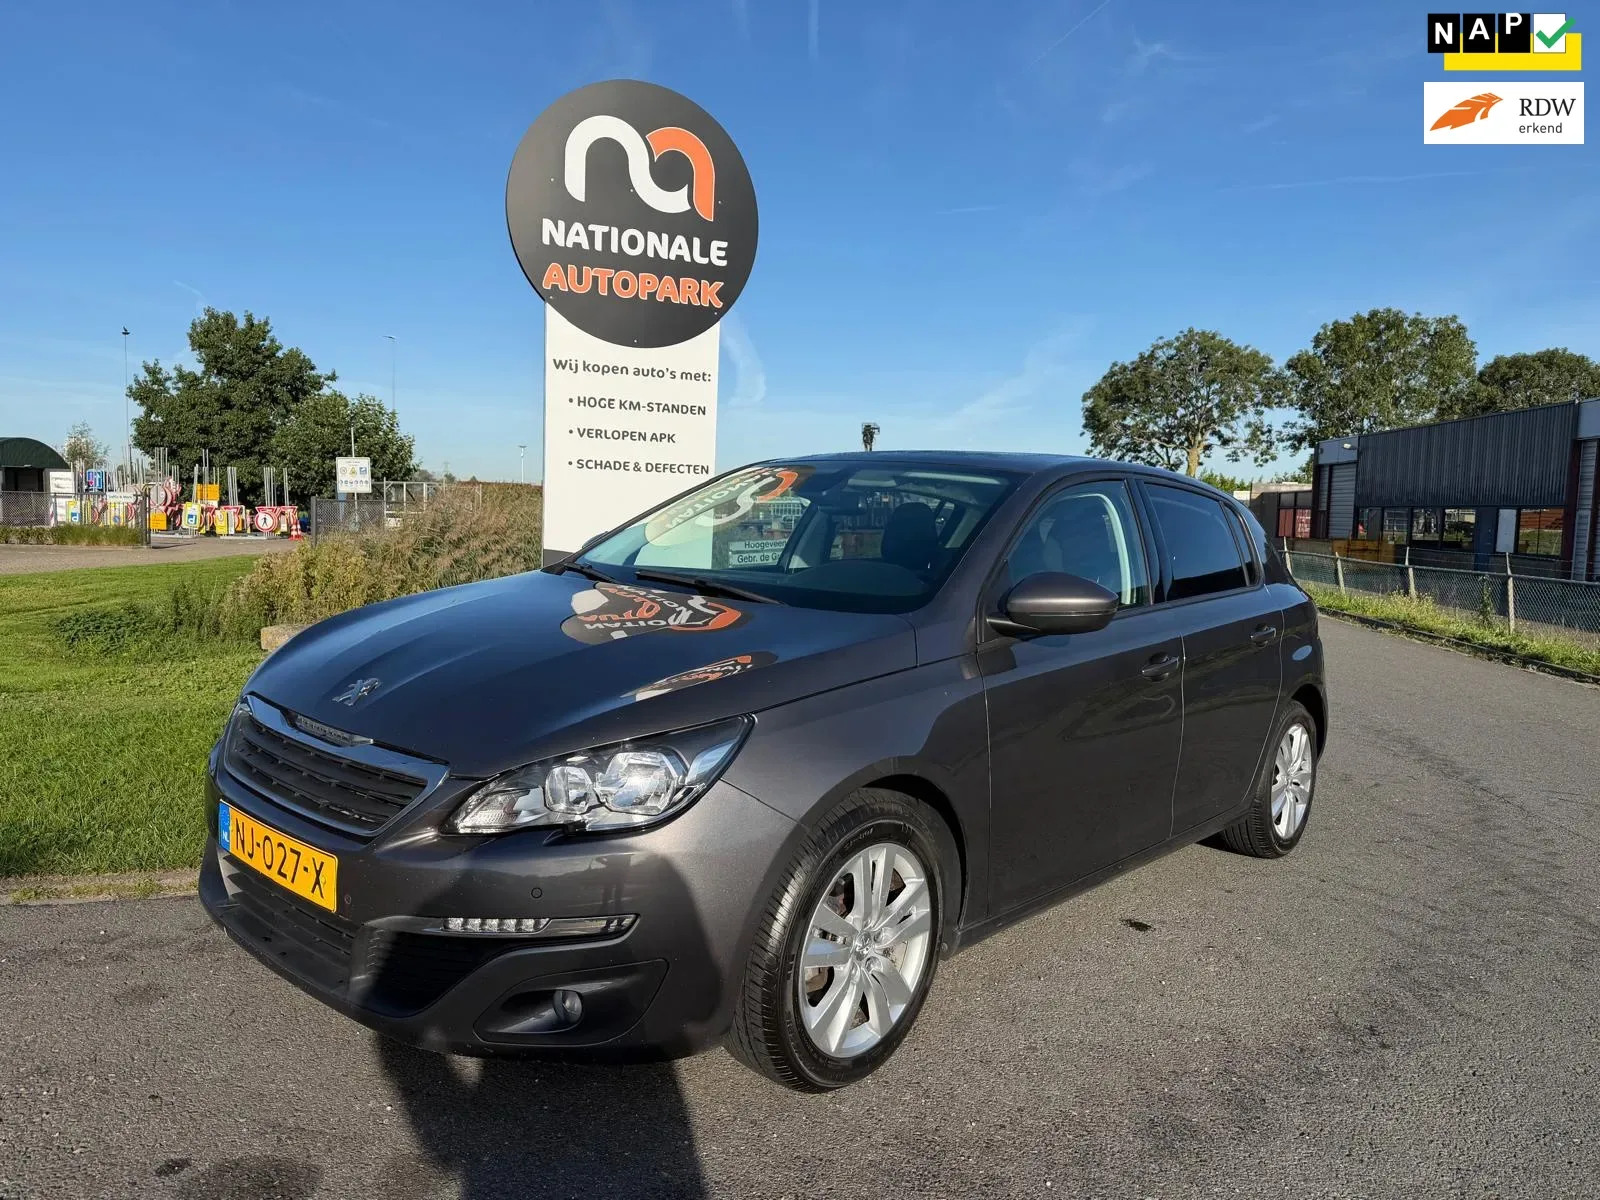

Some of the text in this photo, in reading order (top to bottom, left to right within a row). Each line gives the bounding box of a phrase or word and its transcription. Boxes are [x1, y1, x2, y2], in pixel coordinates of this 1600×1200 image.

[542, 218, 728, 266] NATIONALE
[542, 262, 724, 308] AUTOPARK
[553, 358, 712, 382] Wij kopen auto's met:
[577, 396, 707, 416] HOGE KM-STANDEN
[577, 427, 676, 444] VERLOPEN APK
[576, 458, 709, 475] SCHADE & DEFECTEN
[760, 553, 770, 562] de
[235, 818, 325, 899] NJ-027-X
